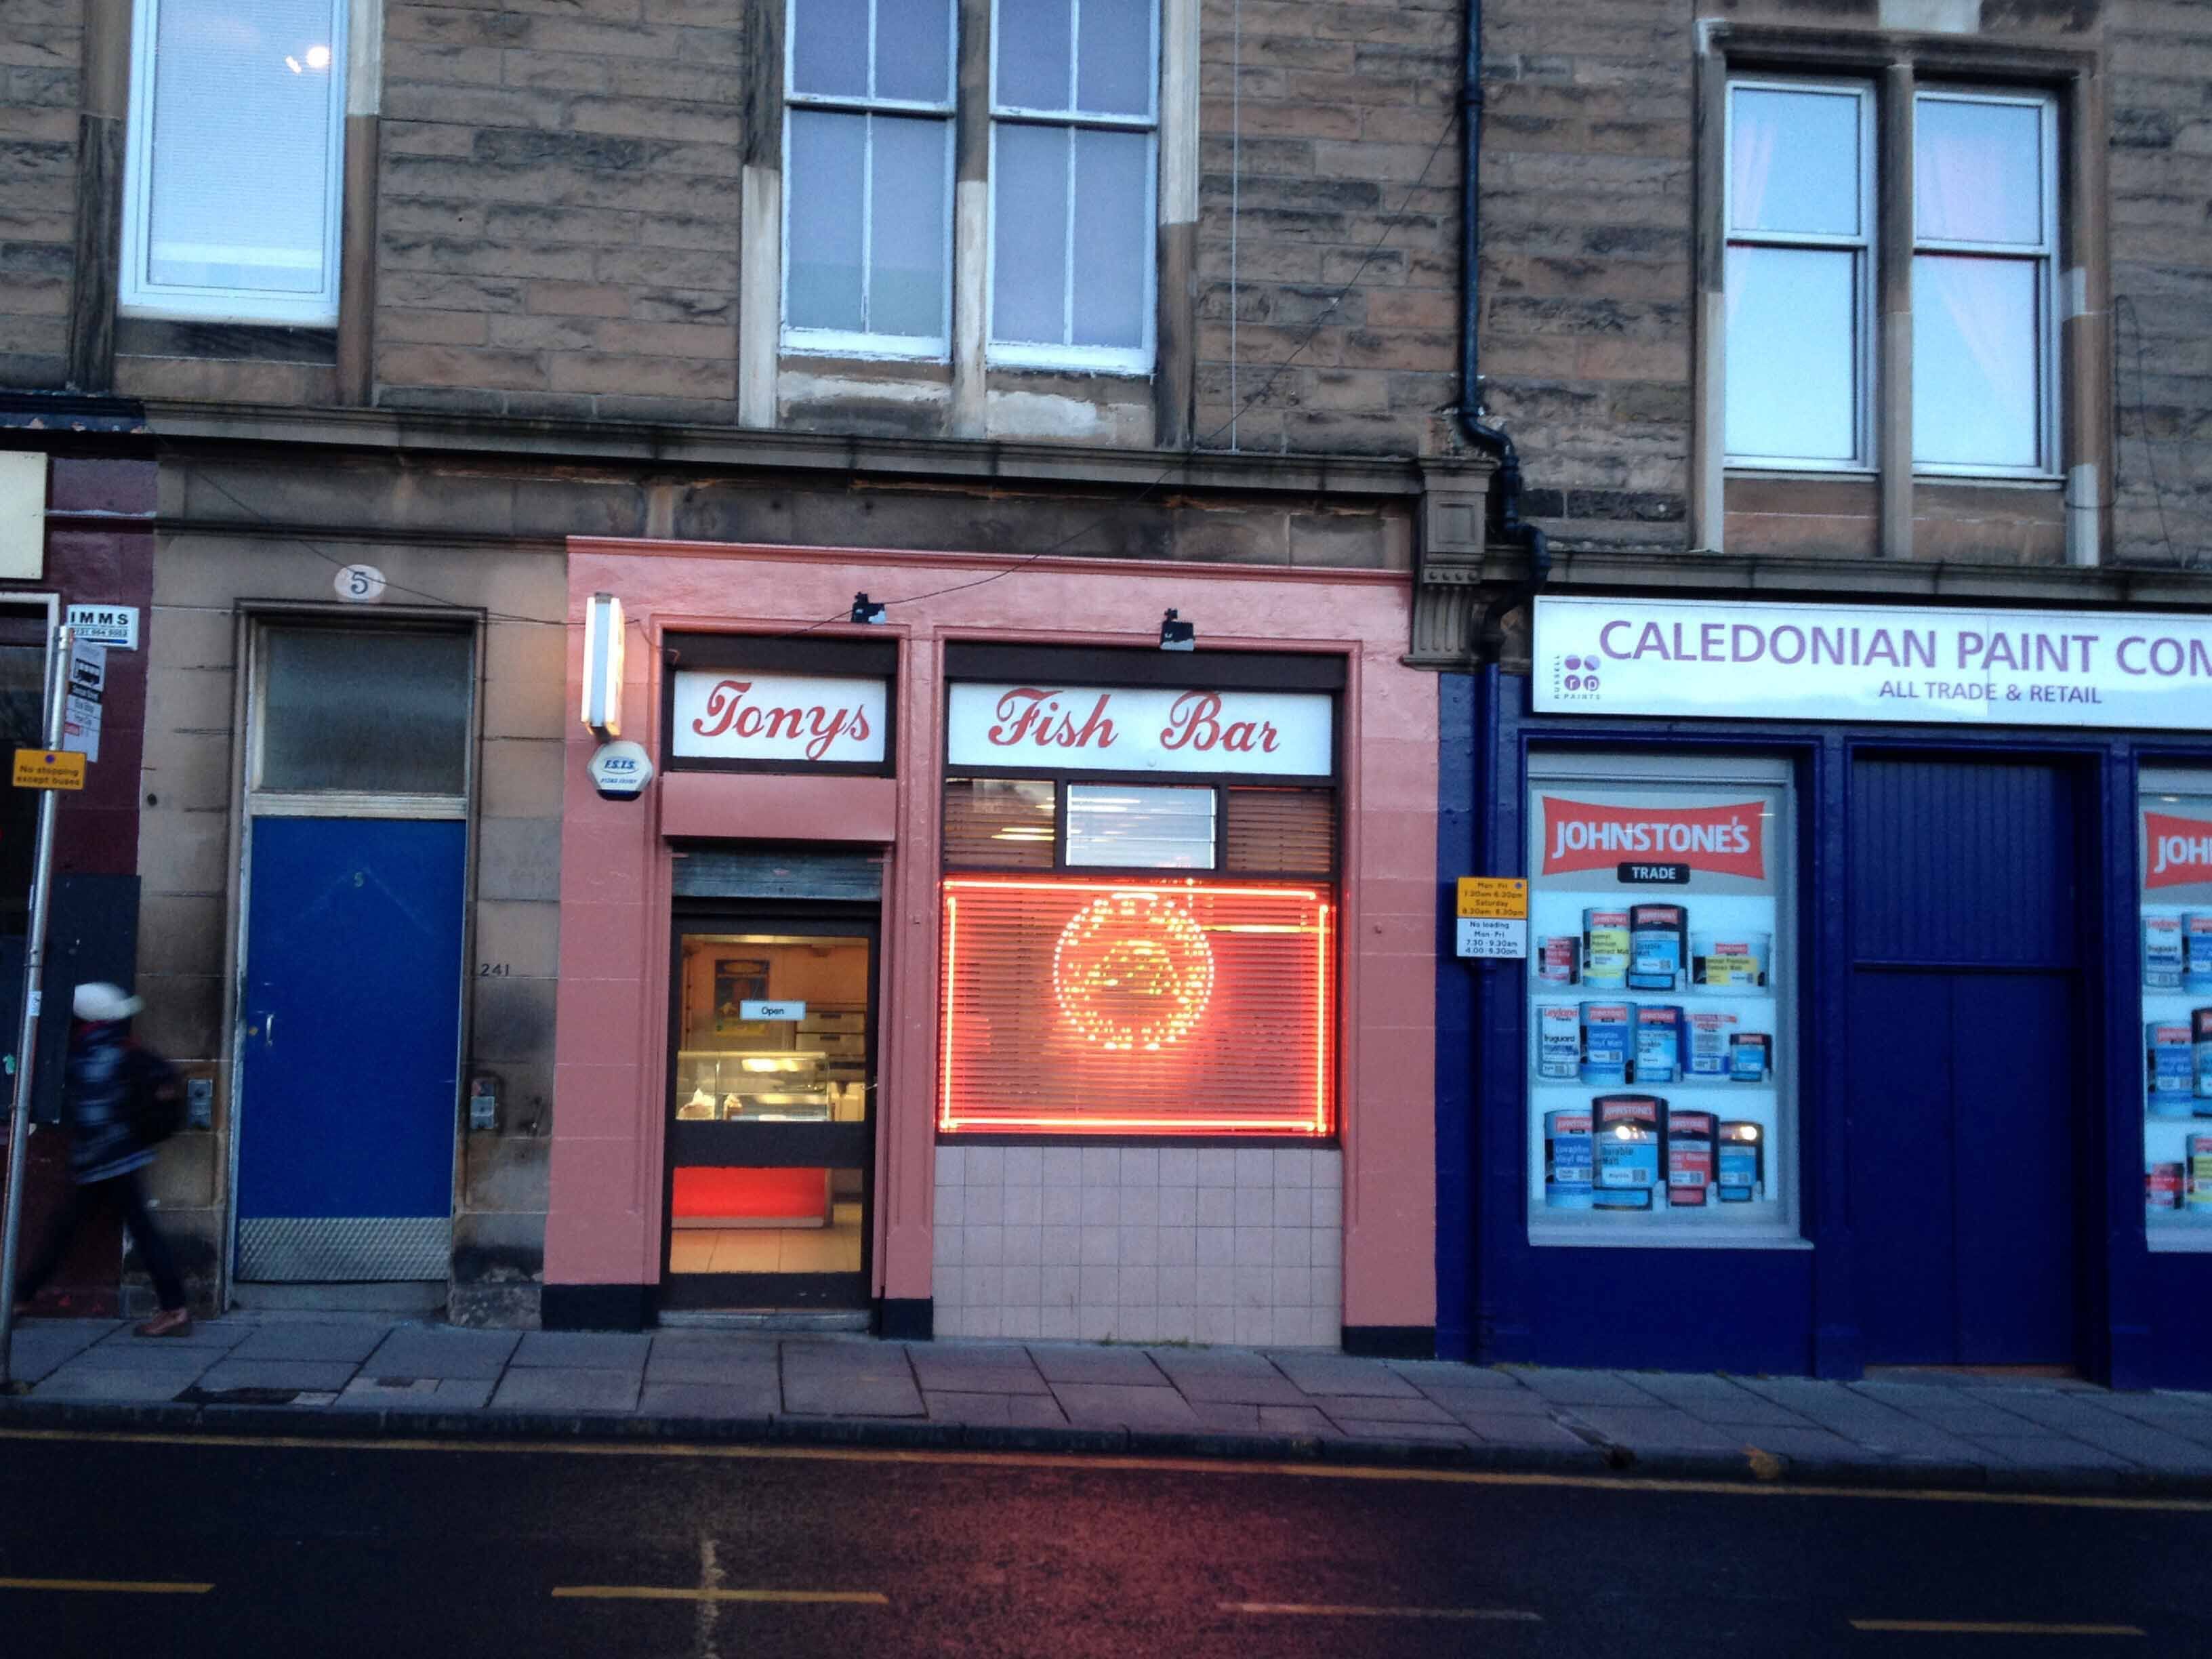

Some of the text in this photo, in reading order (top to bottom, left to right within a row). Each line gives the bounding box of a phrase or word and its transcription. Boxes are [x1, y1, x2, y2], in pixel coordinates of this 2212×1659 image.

[351, 571, 368, 594] 5
[71, 612, 128, 625] IMMS
[1599, 620, 1936, 668] CALEDONIAN
[1958, 631, 2099, 673] PAINT
[1879, 680, 2102, 704] ALL TRADE & RETAIL
[692, 680, 870, 761] Tonys
[988, 687, 1280, 754] Fish Bar
[17, 776, 49, 784] except
[37, 768, 79, 777] stopping
[1552, 816, 1750, 859] JOHNSTONE'S
[2154, 836, 2212, 874] JOH
[1631, 866, 1676, 880] TRADE
[1475, 899, 1509, 907] Saturday
[1482, 921, 1510, 929] loading
[760, 1006, 785, 1016] Open
